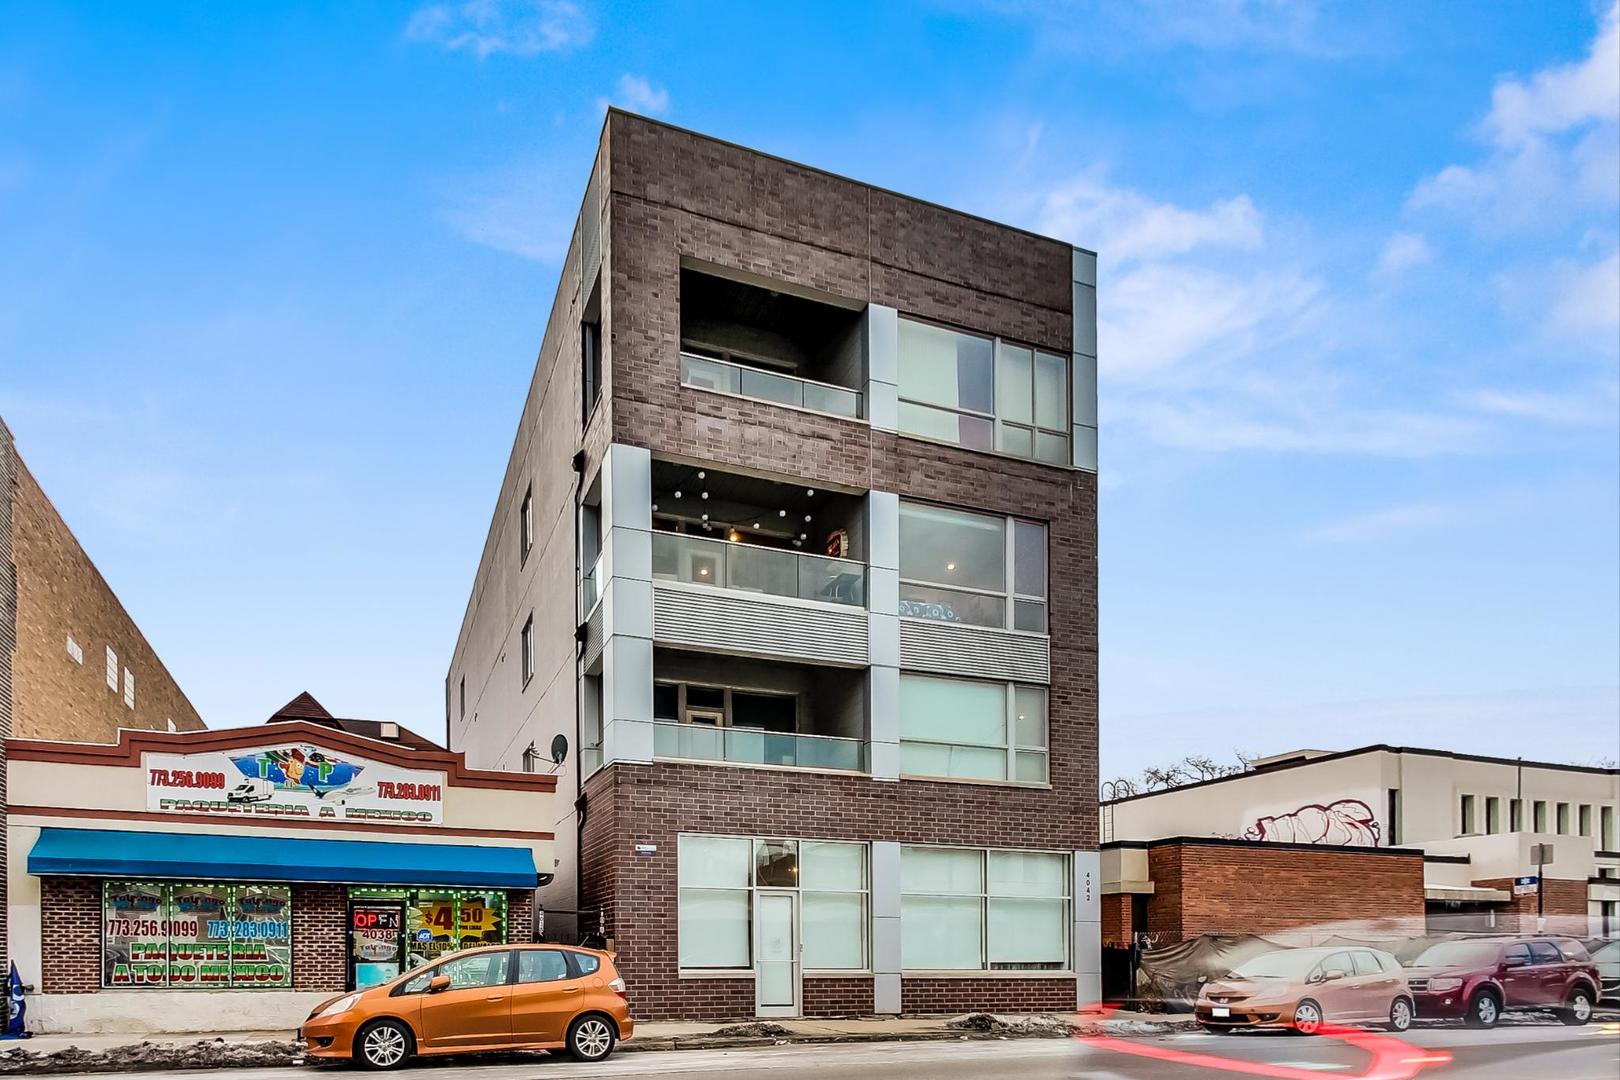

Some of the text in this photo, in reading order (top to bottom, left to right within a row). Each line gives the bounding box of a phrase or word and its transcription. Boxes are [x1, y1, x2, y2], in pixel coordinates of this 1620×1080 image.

[149, 769, 226, 789] 773.256.9099
[376, 781, 441, 801] 773.283.0911
[160, 799, 433, 822] PAQUETERIA A MEXICO
[108, 919, 288, 938] 773.256.9099 773283.0911
[362, 930, 393, 940] 4038
[131, 943, 267, 960] PAQUETERIA
[113, 964, 130, 982] A
[200, 965, 284, 982] MEXICO
